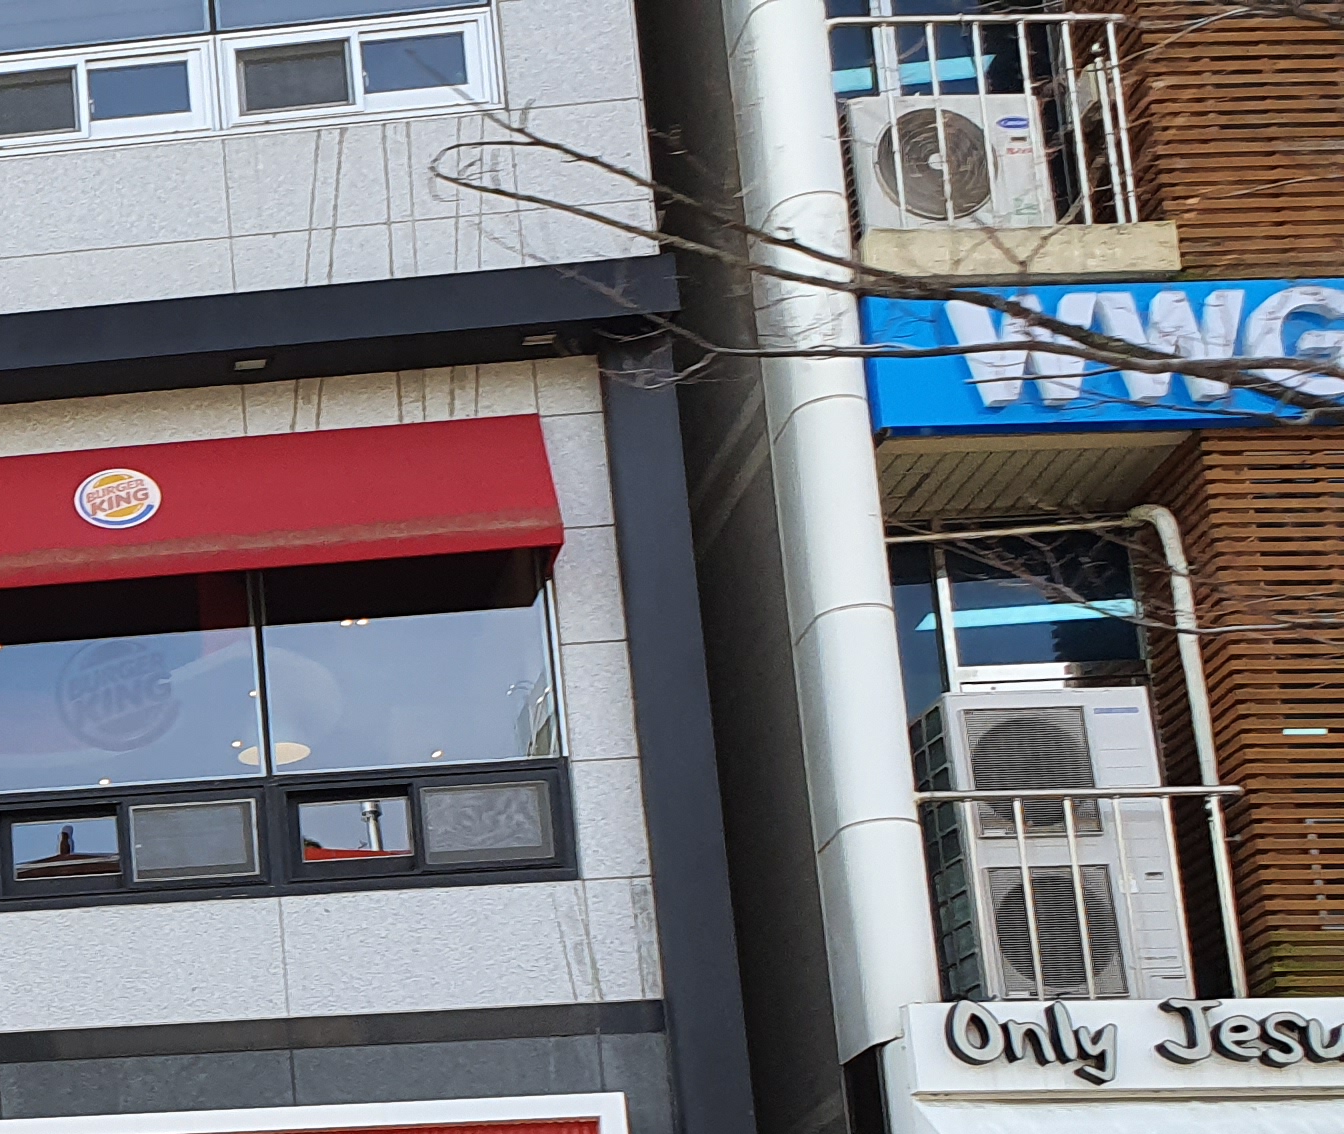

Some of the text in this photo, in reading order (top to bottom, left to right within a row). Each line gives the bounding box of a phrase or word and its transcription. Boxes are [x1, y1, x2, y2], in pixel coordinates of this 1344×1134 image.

[86, 479, 144, 503] BURGER
[91, 488, 149, 516] KING
[946, 998, 1118, 1085] Only
